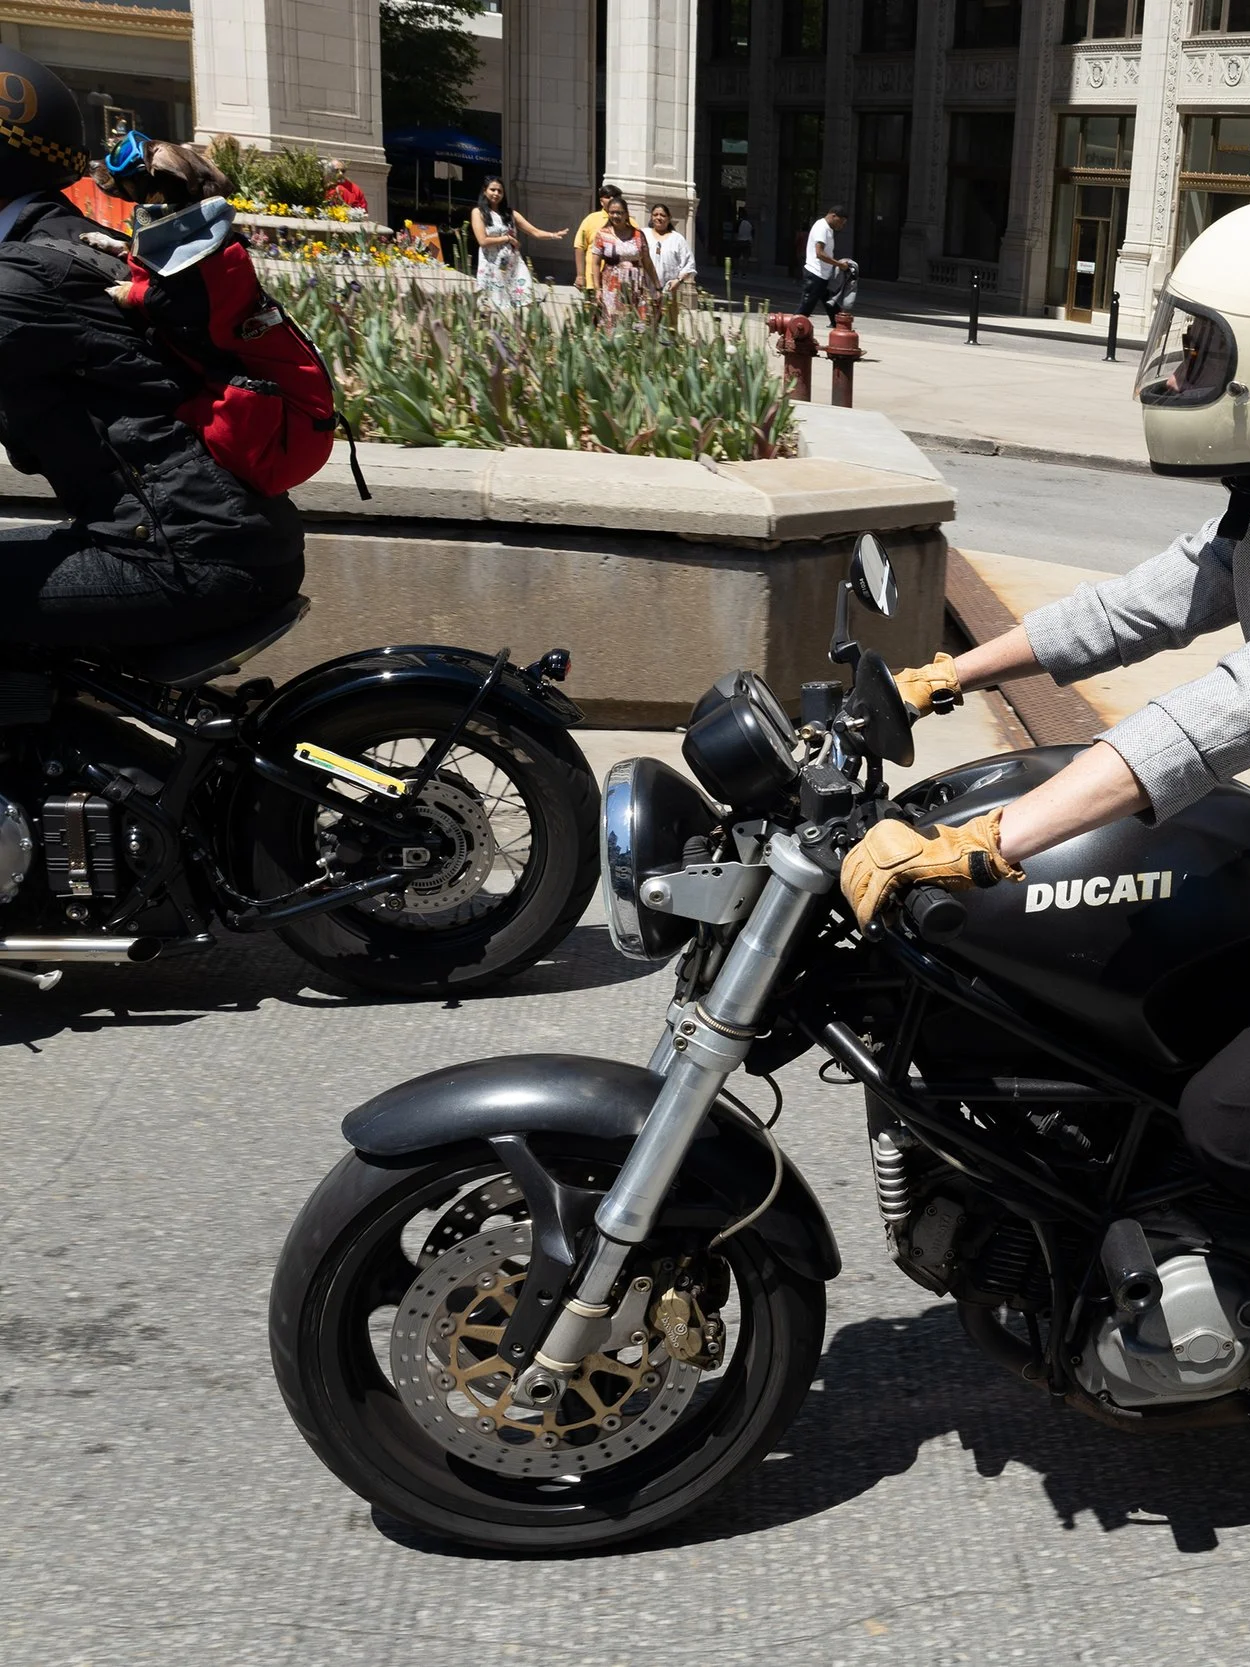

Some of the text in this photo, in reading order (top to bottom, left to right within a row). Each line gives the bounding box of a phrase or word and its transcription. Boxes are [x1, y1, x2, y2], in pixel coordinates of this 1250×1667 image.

[0, 71, 38, 124] 9
[1025, 870, 1173, 913] DUCATI
[661, 1316, 680, 1348] brembo
